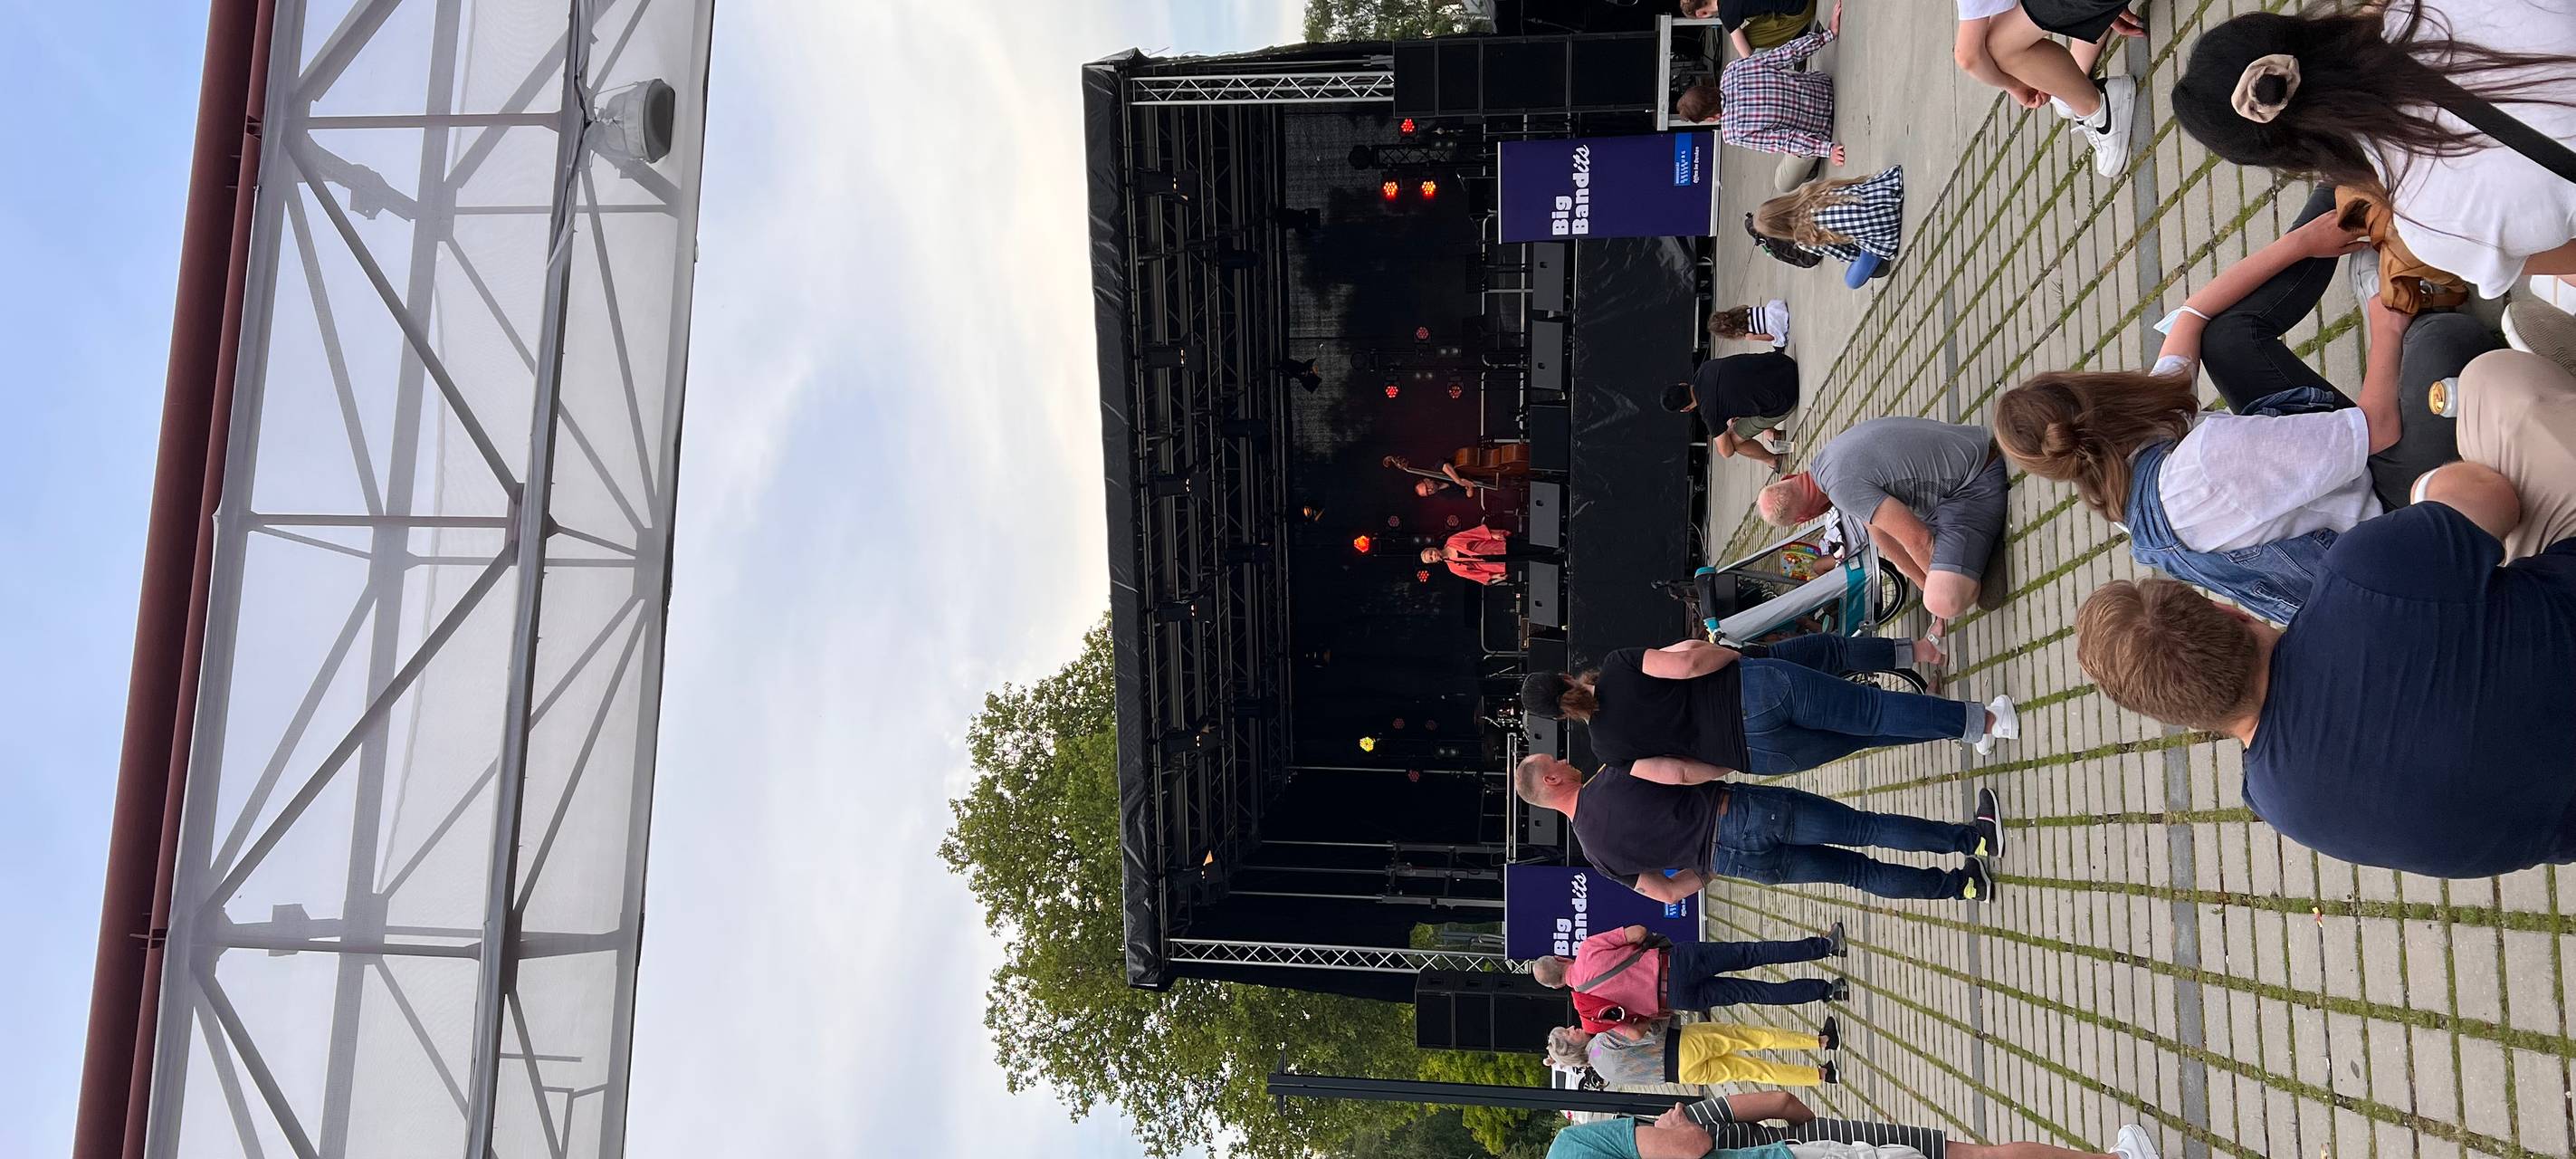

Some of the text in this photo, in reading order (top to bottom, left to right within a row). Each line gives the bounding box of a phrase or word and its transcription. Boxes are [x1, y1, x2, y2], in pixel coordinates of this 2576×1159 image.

[1572, 144, 1590, 235] Bandits
[1551, 196, 1572, 235] Big
[1553, 918, 1571, 956] Big
